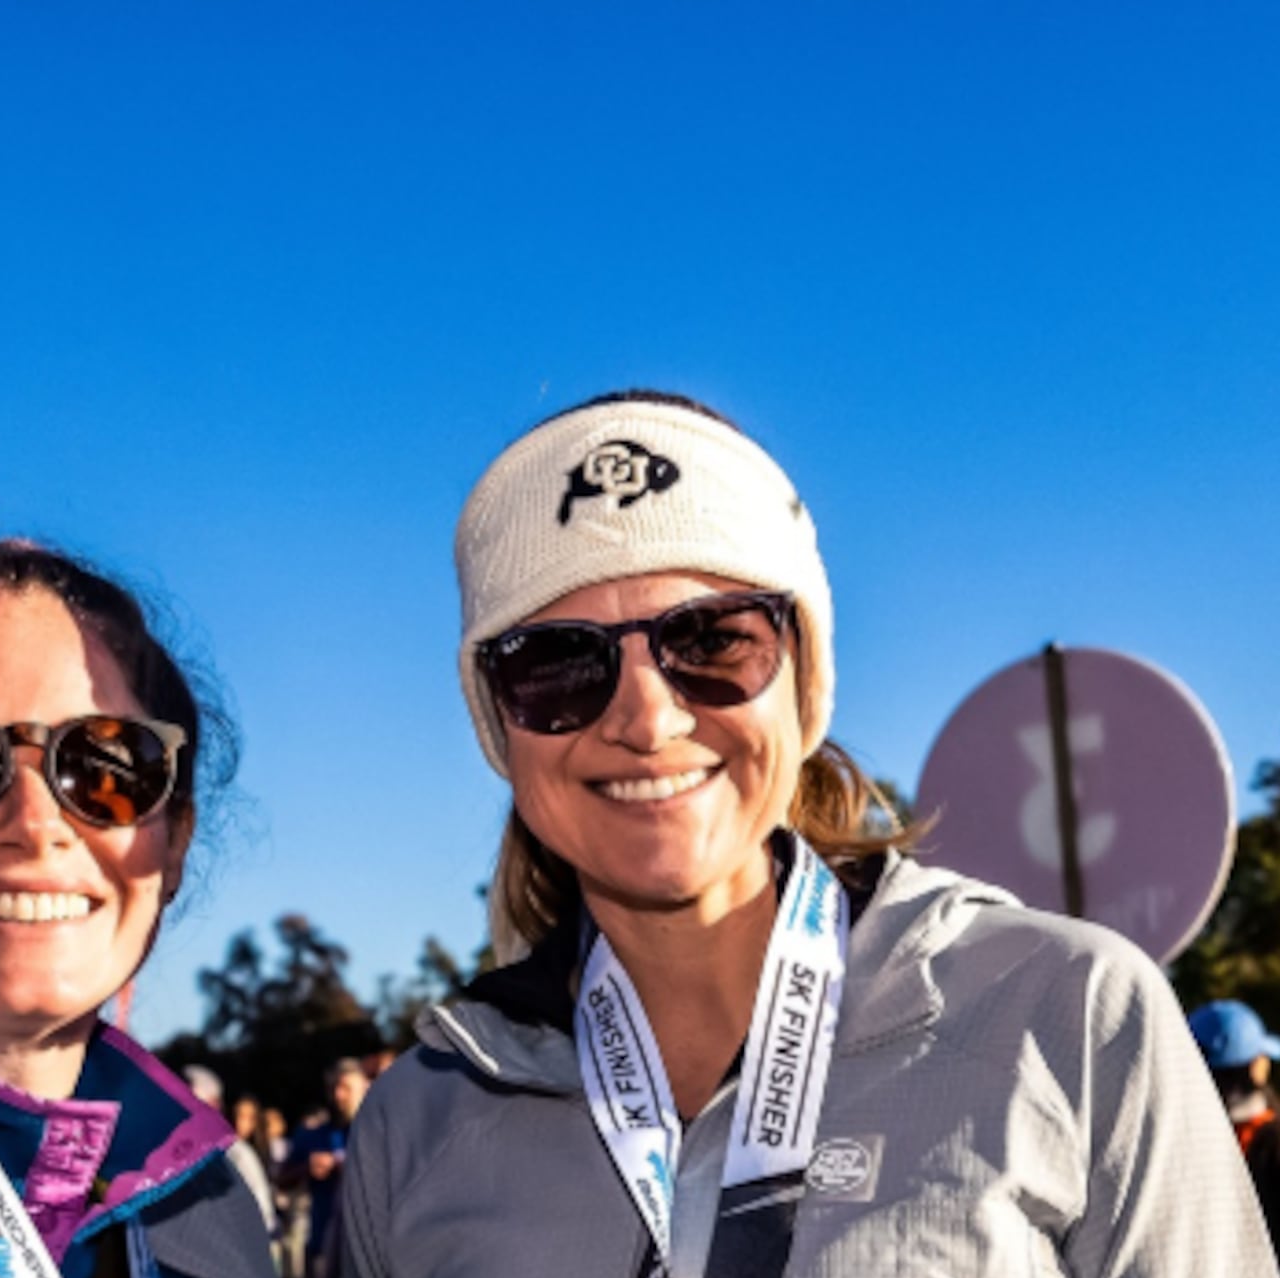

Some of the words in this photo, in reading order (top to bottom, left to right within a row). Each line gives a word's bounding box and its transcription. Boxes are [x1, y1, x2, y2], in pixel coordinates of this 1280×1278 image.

[786, 963, 817, 1006] 5K
[588, 984, 643, 1094] FINISHER
[757, 1006, 807, 1149] FINISHER
[623, 1104, 654, 1129] K
